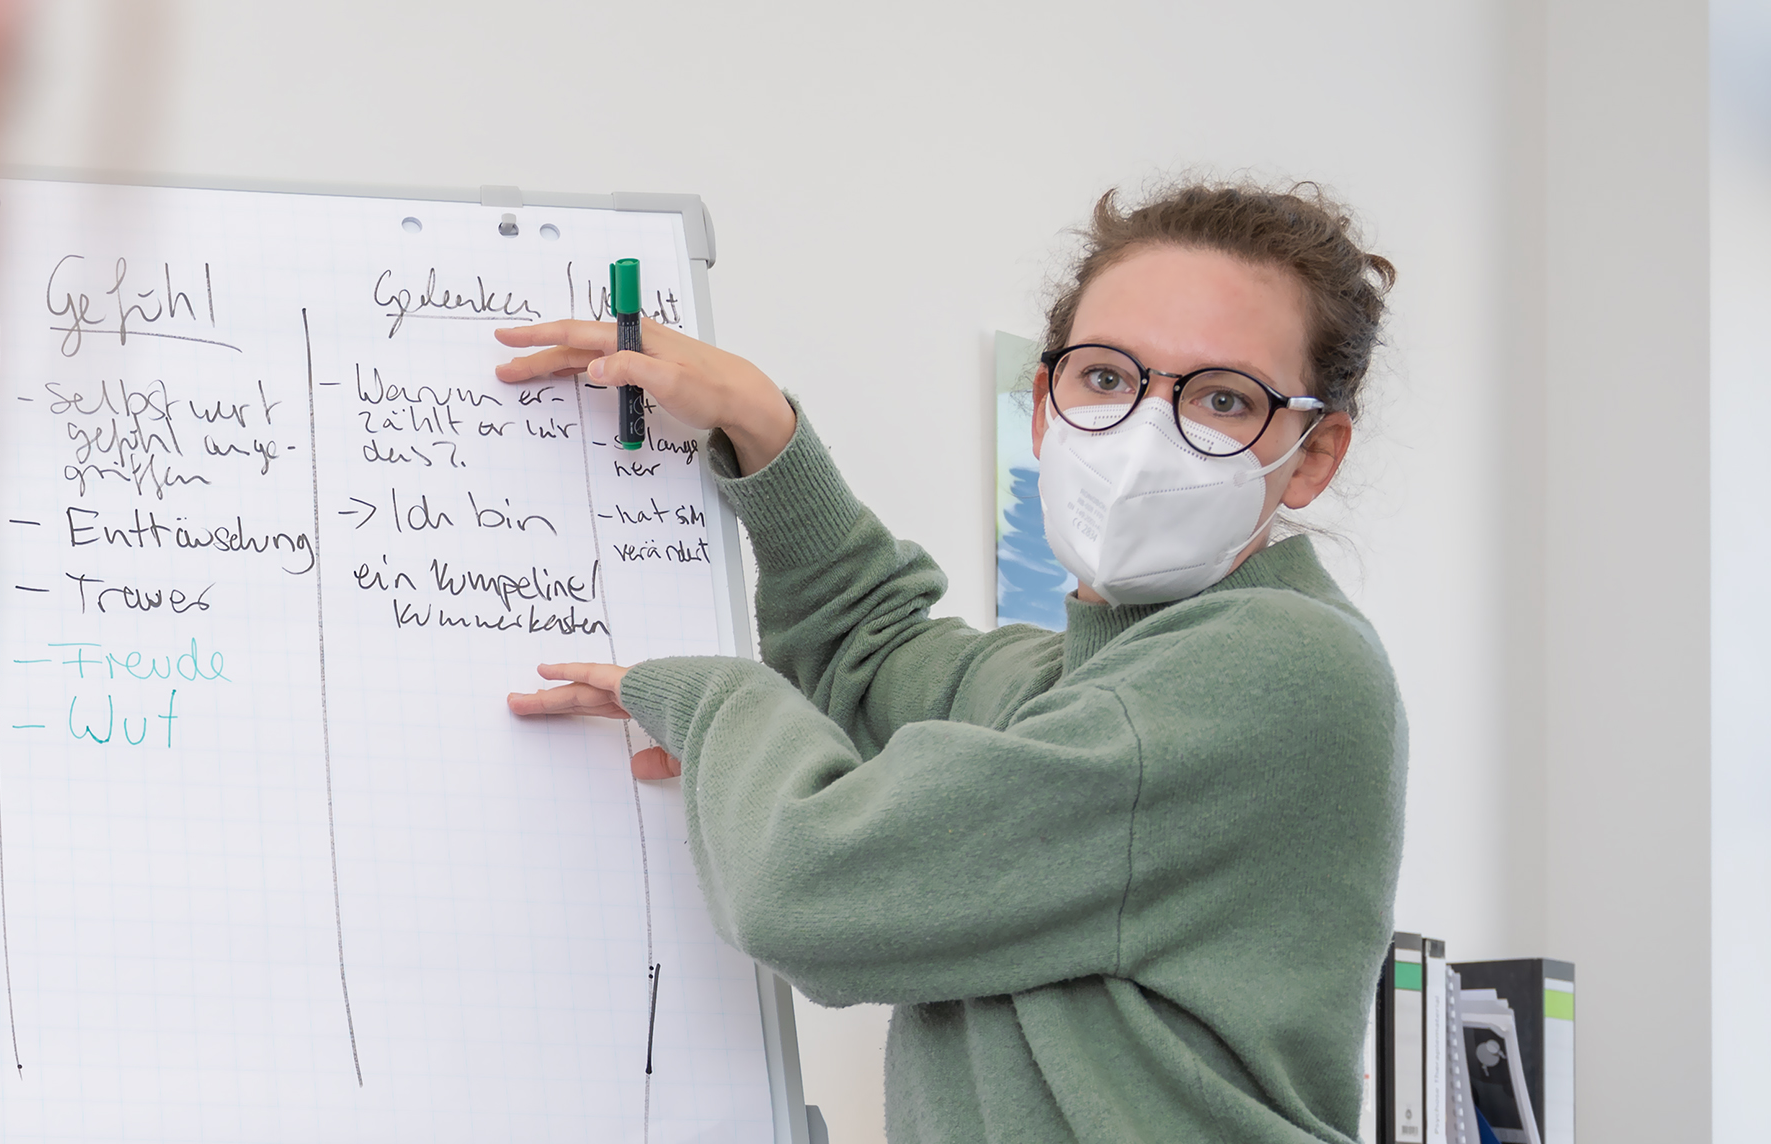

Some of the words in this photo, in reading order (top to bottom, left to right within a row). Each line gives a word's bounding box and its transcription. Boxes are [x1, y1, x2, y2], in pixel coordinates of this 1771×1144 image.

[46, 254, 216, 358] Gefühl
[356, 362, 503, 406] Warum
[614, 460, 662, 478] her
[391, 487, 454, 533] Ich
[467, 491, 558, 537] bin
[615, 498, 670, 524] hat
[353, 553, 417, 592] ein
[48, 636, 233, 683] Freude
[69, 688, 178, 749] Wut
